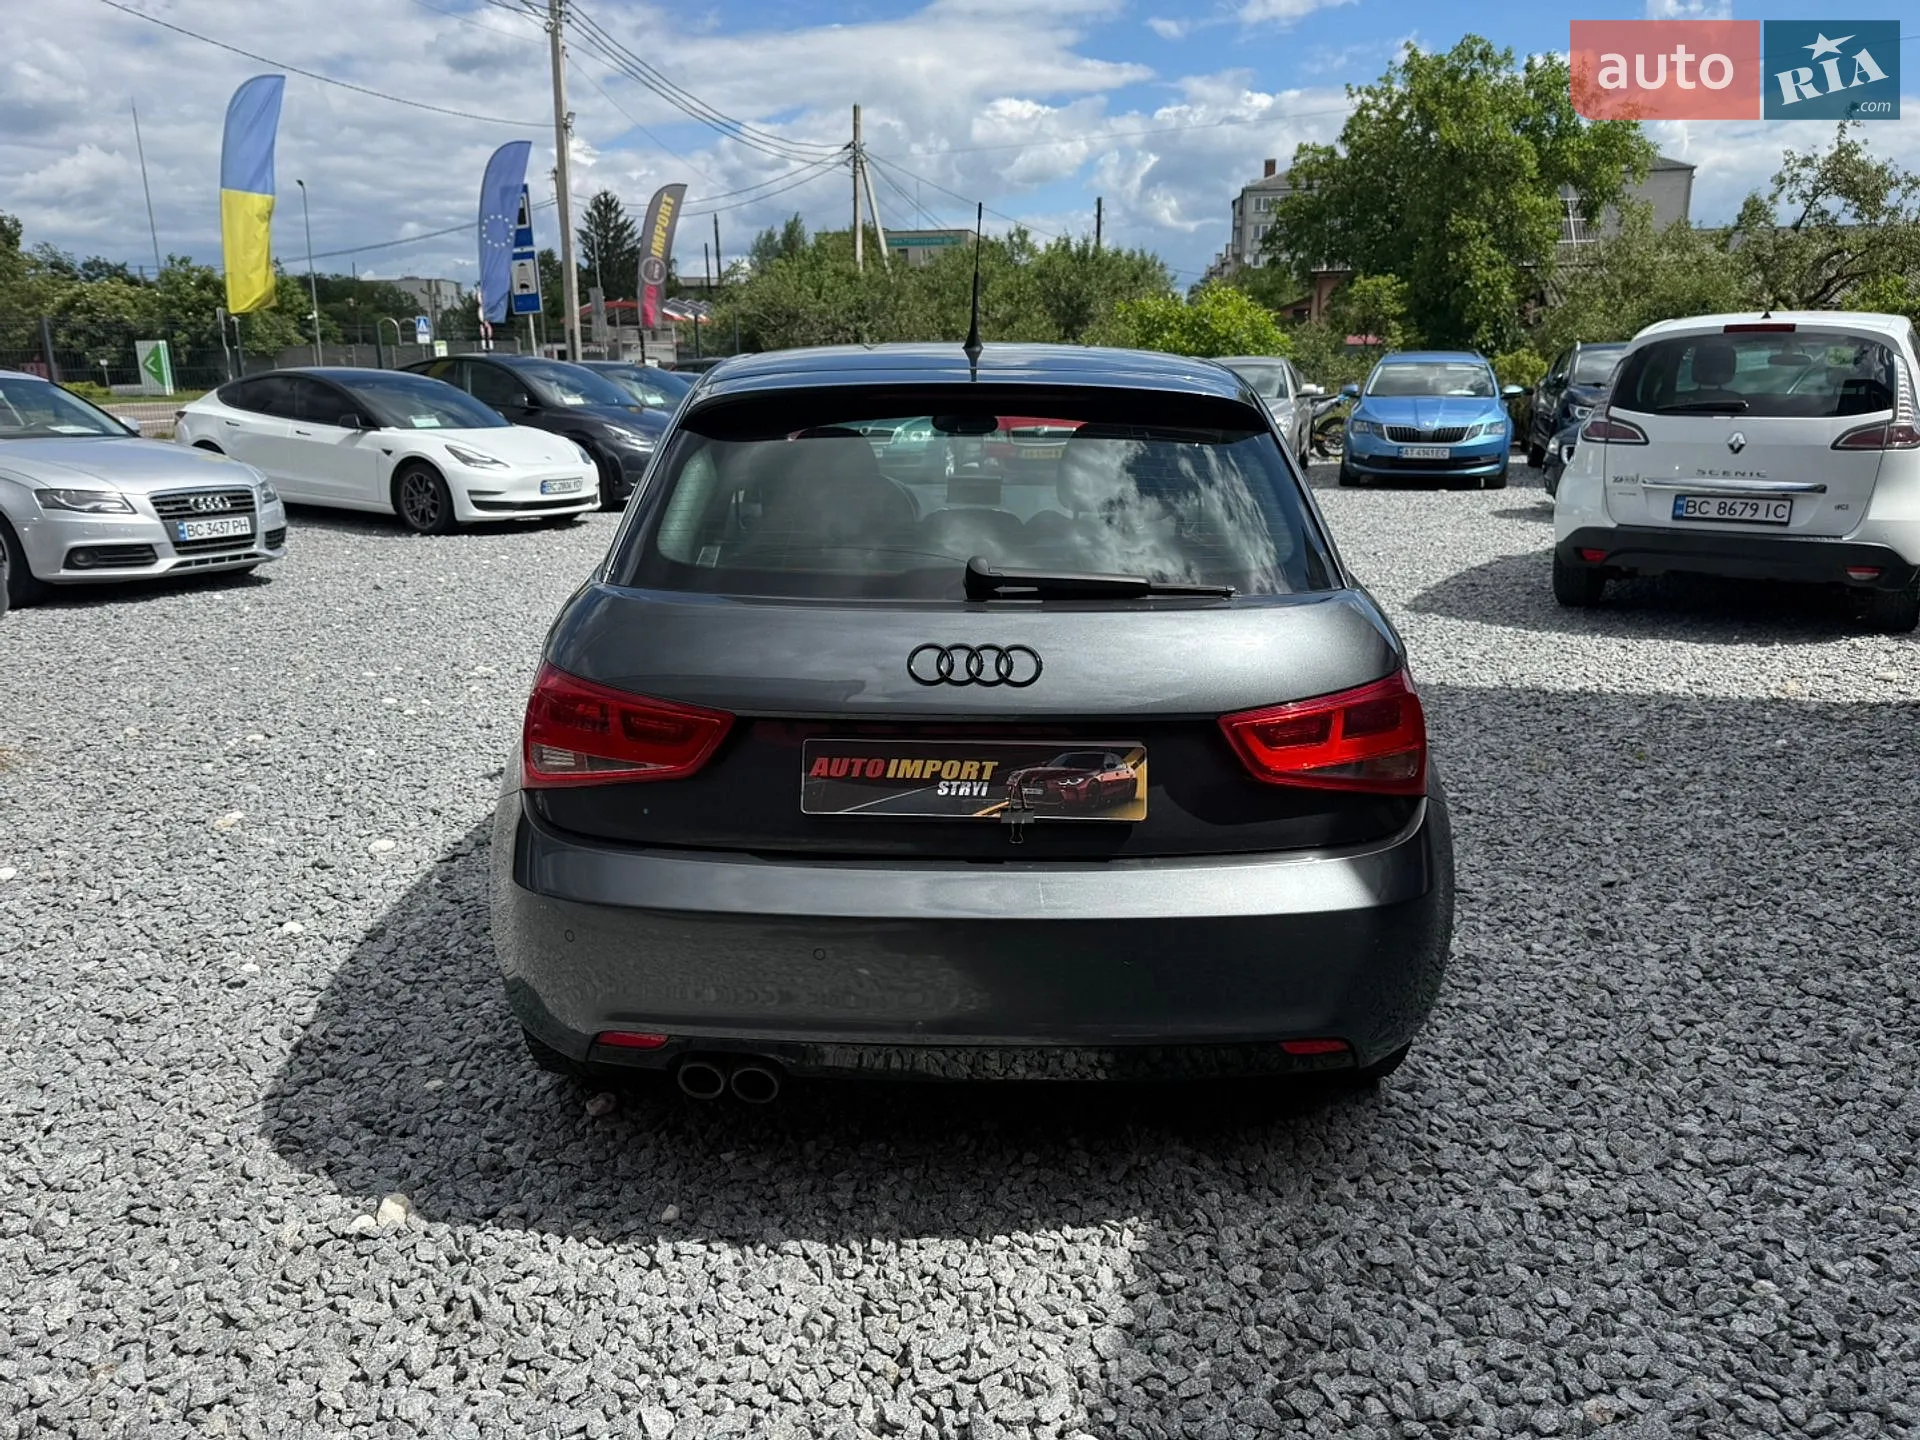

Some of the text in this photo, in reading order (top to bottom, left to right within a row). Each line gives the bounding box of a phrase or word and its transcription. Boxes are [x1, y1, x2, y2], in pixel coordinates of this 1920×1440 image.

[651, 192, 675, 258] IMPORT
[1695, 469, 1768, 478] SCENIC
[1685, 500, 1788, 519] BC 8679 IC
[187, 519, 248, 537] BC 3437 PH
[810, 757, 999, 780] AUTO IMPORT
[937, 780, 989, 797] STRYI
